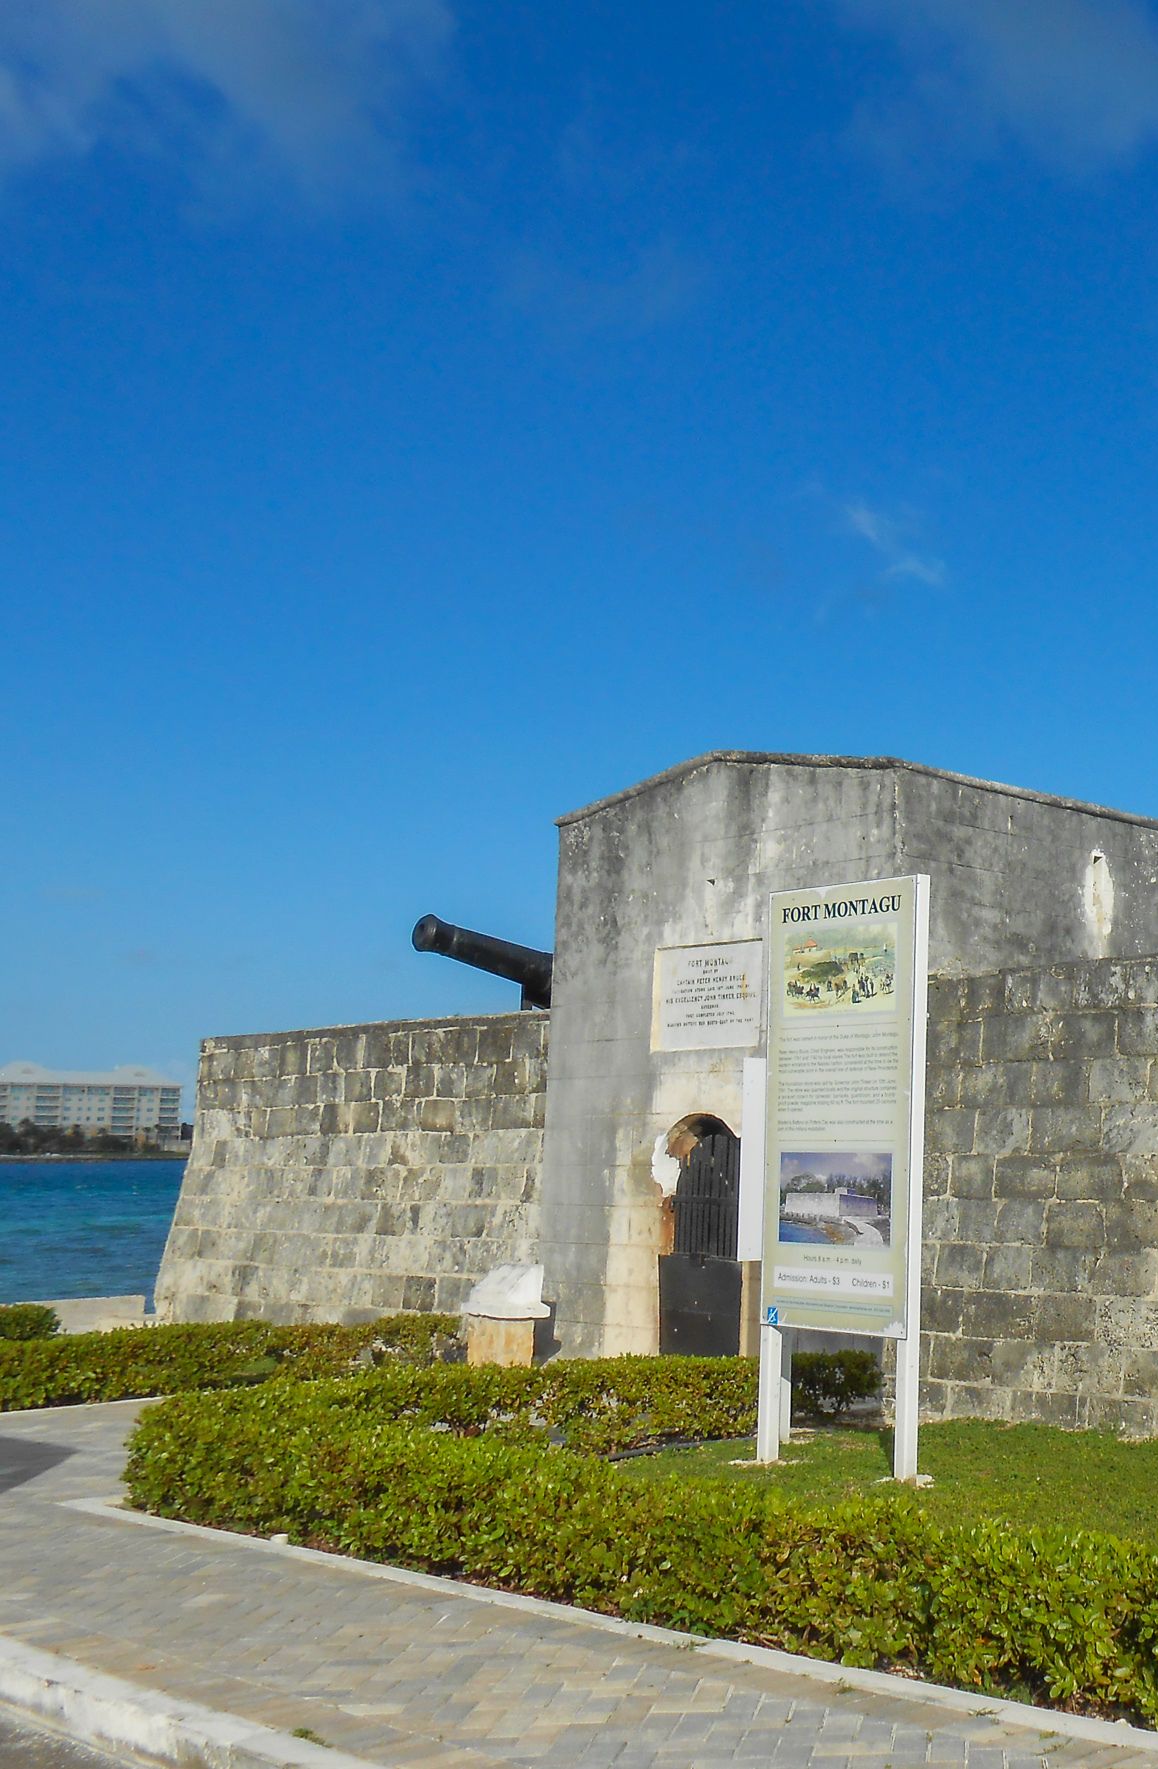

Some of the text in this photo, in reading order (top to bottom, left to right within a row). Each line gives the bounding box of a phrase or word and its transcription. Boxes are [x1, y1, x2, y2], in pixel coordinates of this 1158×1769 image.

[782, 895, 902, 923] FORT MONTAGU
[832, 1276, 840, 1286] $3
[851, 1278, 877, 1289] Children
[882, 1280, 890, 1290] $1
